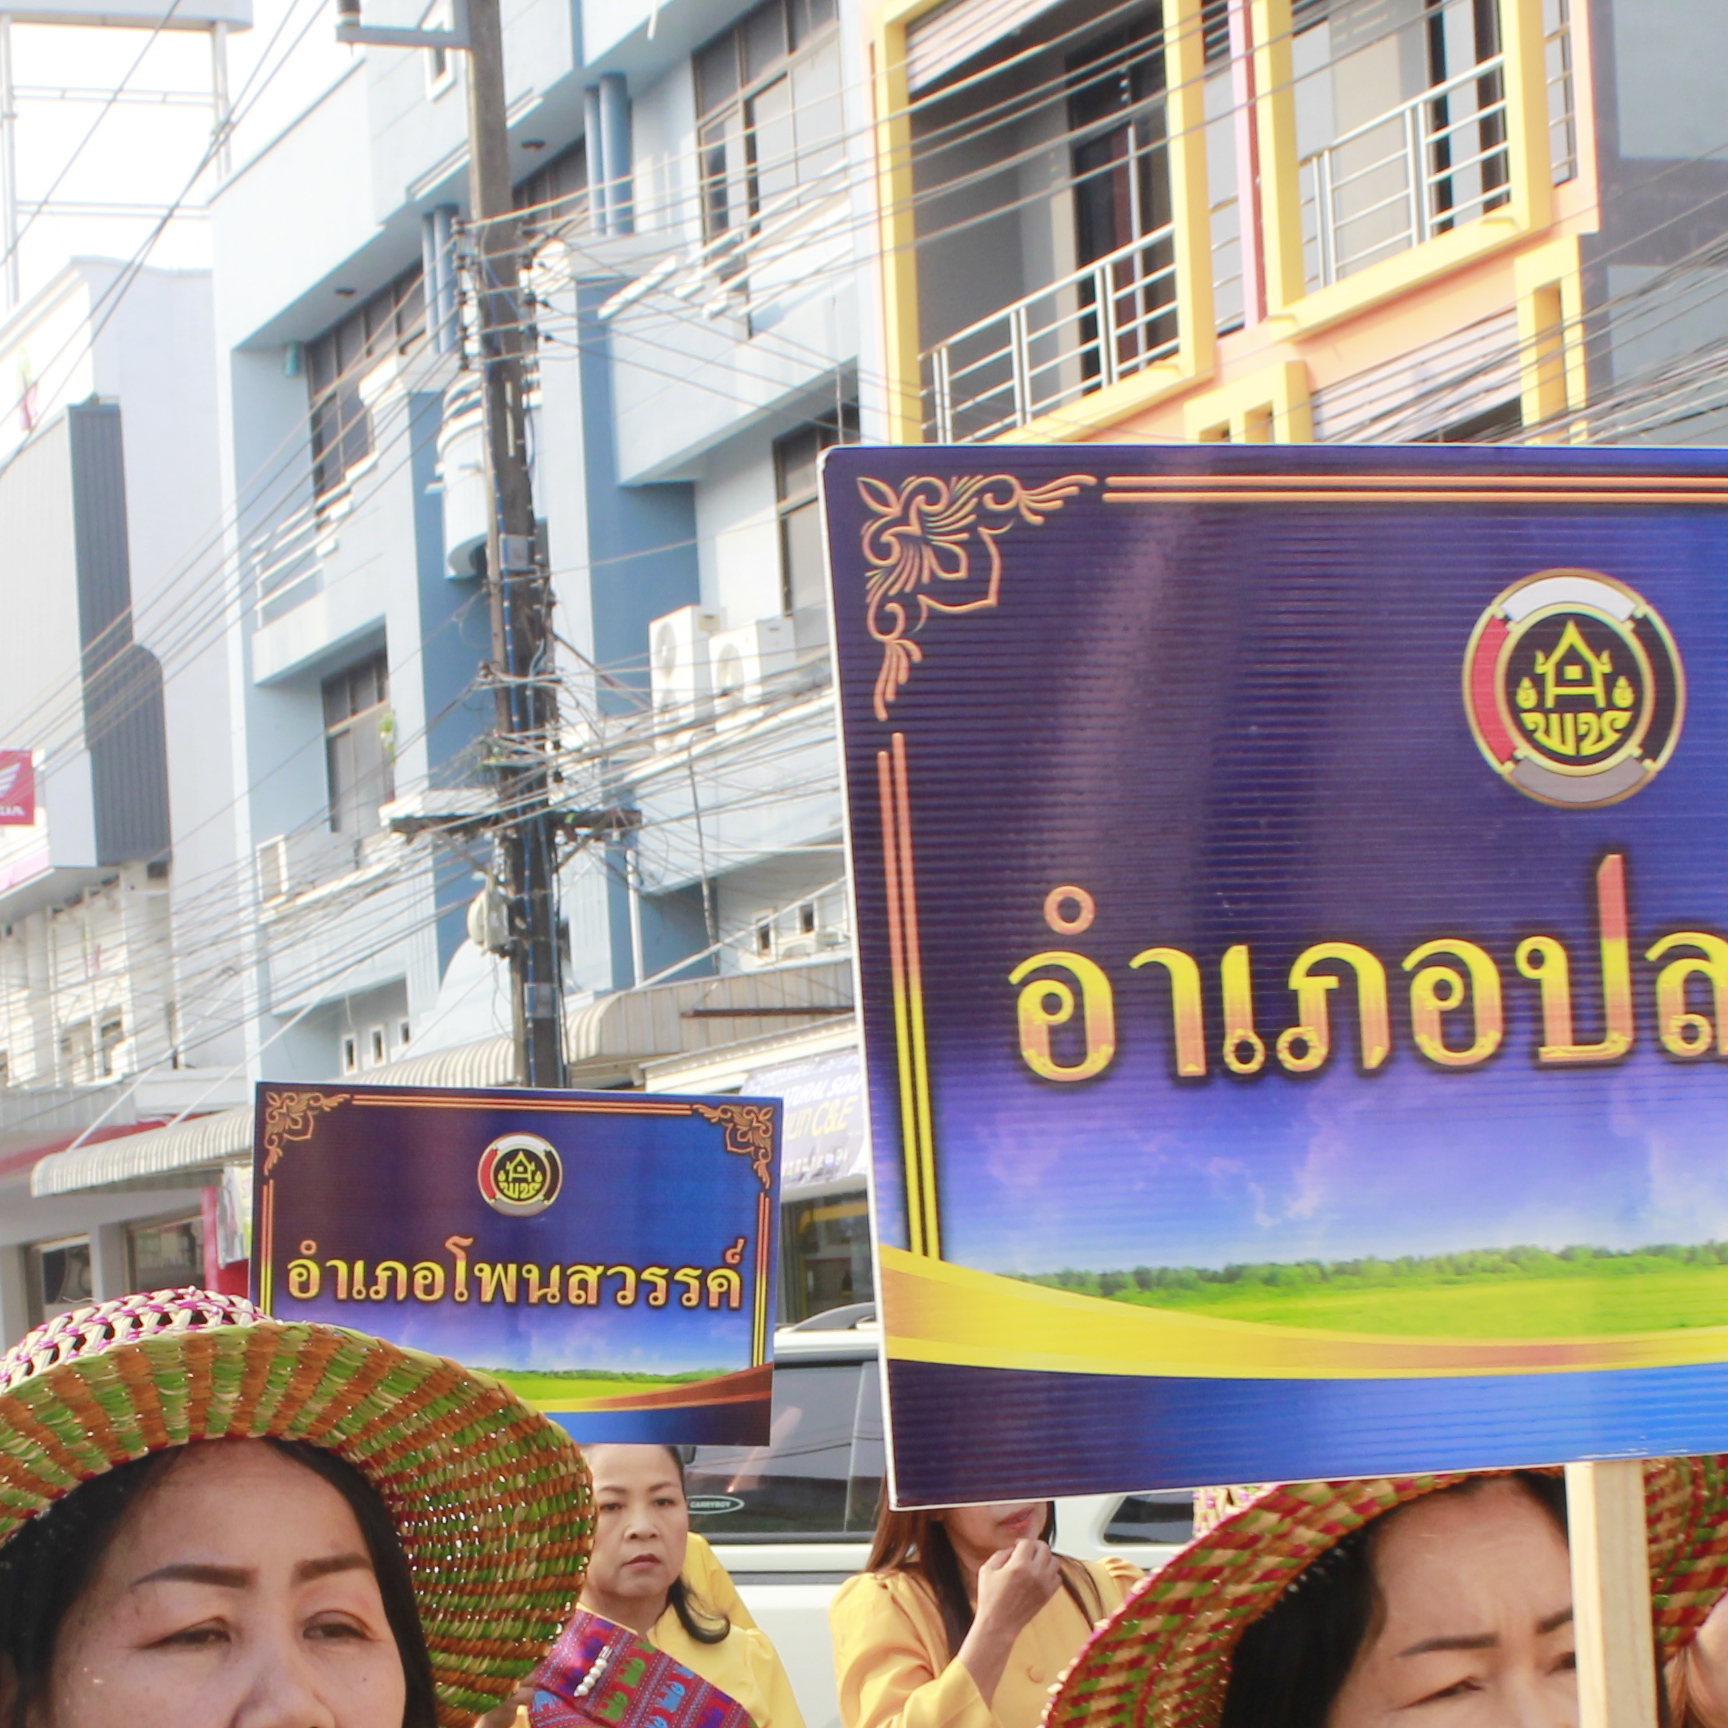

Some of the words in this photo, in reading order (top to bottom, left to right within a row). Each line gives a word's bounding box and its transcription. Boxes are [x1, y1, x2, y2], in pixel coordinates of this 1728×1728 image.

[286, 1235, 746, 1310] อำเภอโพนสวรรค์
[689, 1500, 732, 1509] CARRYBOY
